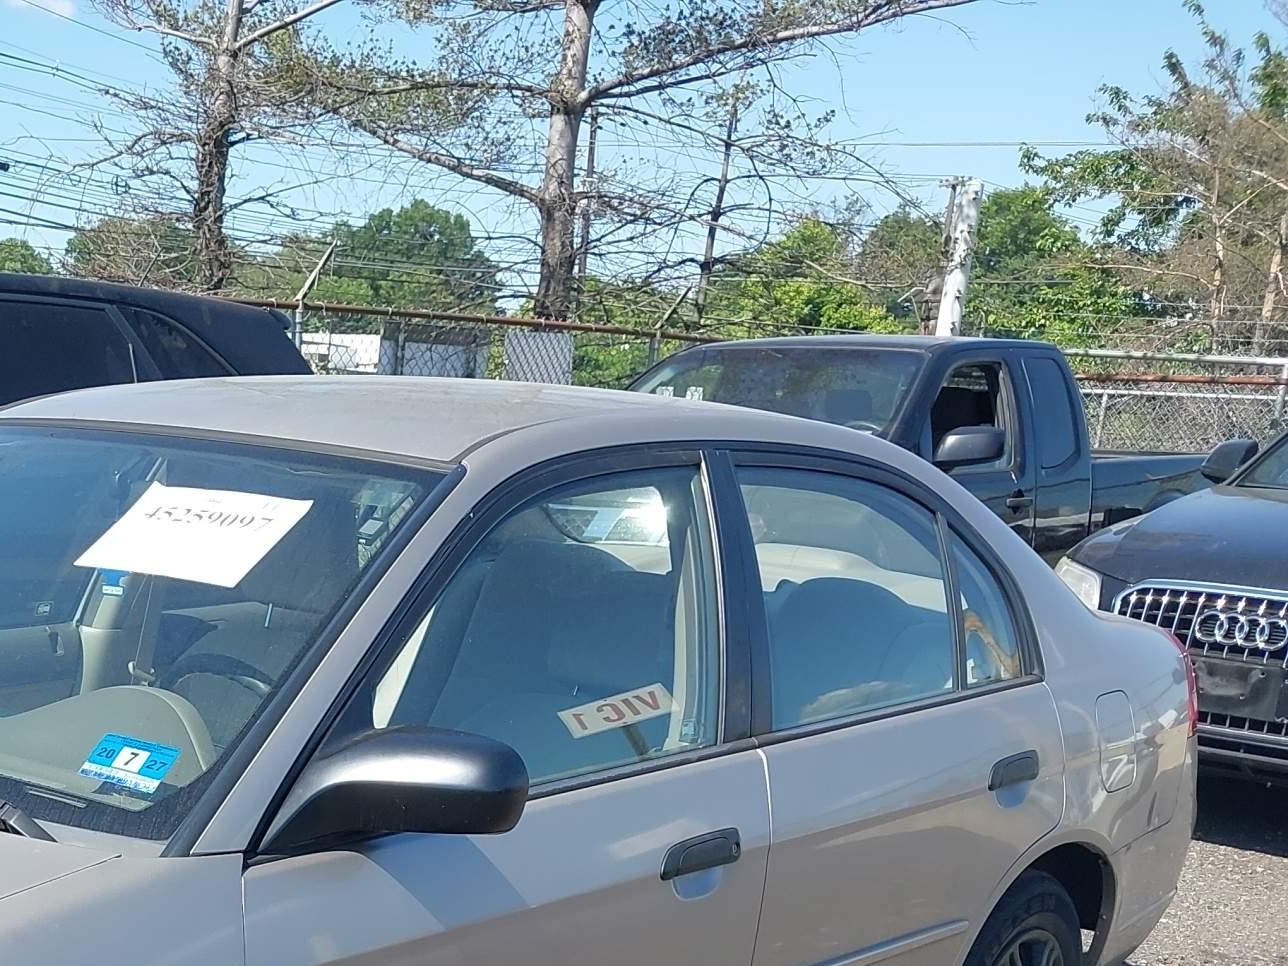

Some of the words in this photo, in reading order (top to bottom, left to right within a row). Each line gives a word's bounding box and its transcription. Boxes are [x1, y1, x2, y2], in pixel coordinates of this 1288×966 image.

[144, 505, 275, 532] 45259097
[95, 747, 117, 760] 20
[123, 752, 140, 767] 7
[146, 759, 169, 772] 27
